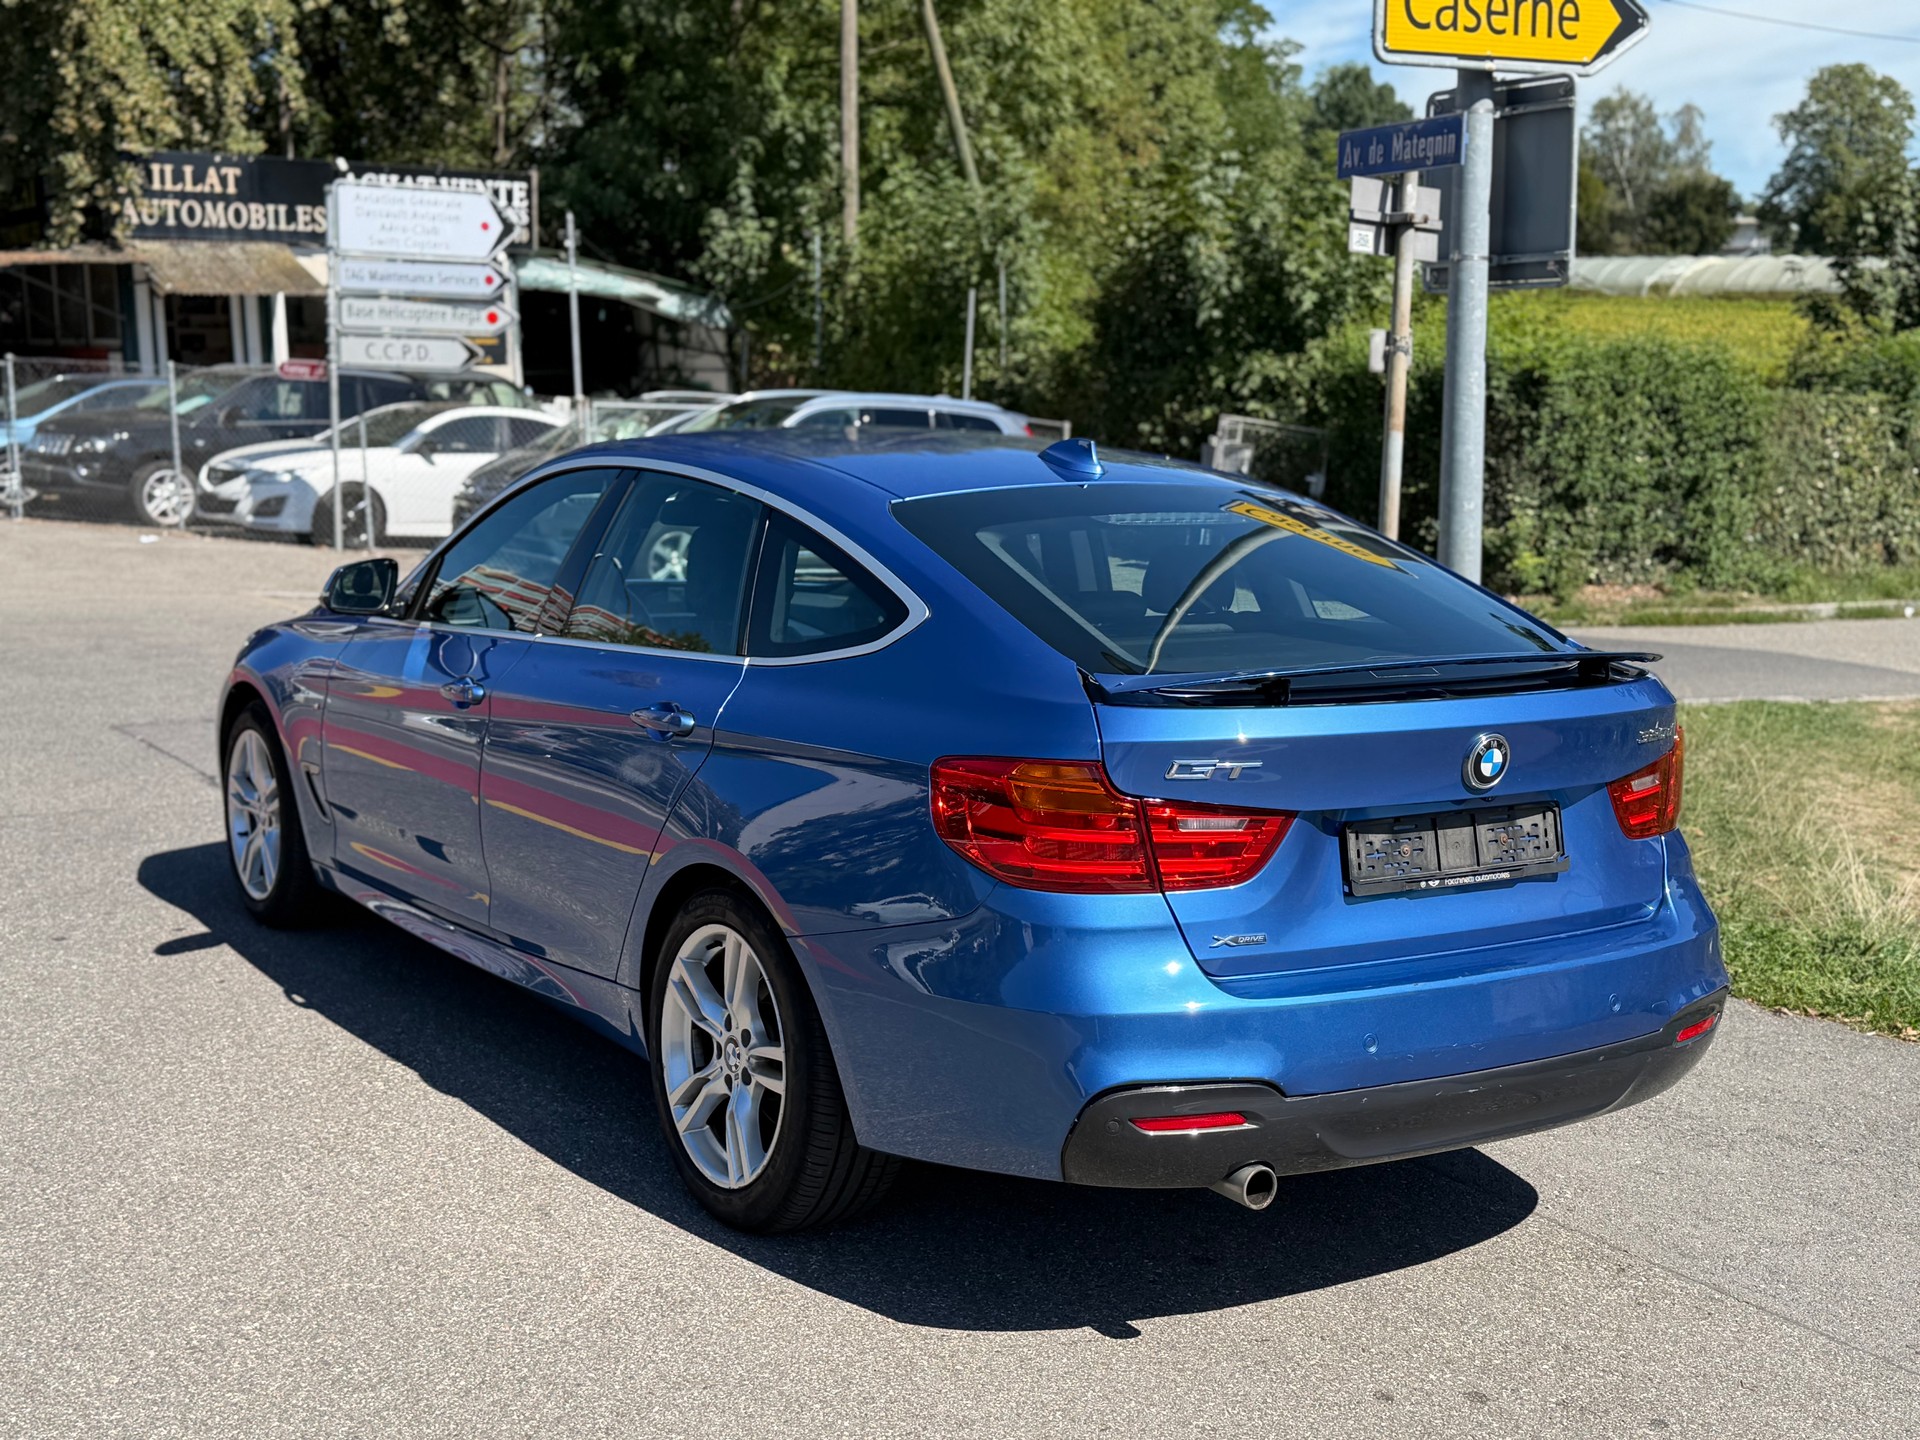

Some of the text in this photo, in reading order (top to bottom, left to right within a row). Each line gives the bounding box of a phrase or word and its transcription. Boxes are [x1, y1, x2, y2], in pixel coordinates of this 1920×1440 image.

[1404, 0, 1580, 41] Caserne
[1343, 129, 1456, 169] Av. de Mategnin
[122, 197, 328, 234] AUTOMOBILES
[1164, 760, 1263, 780] GT
